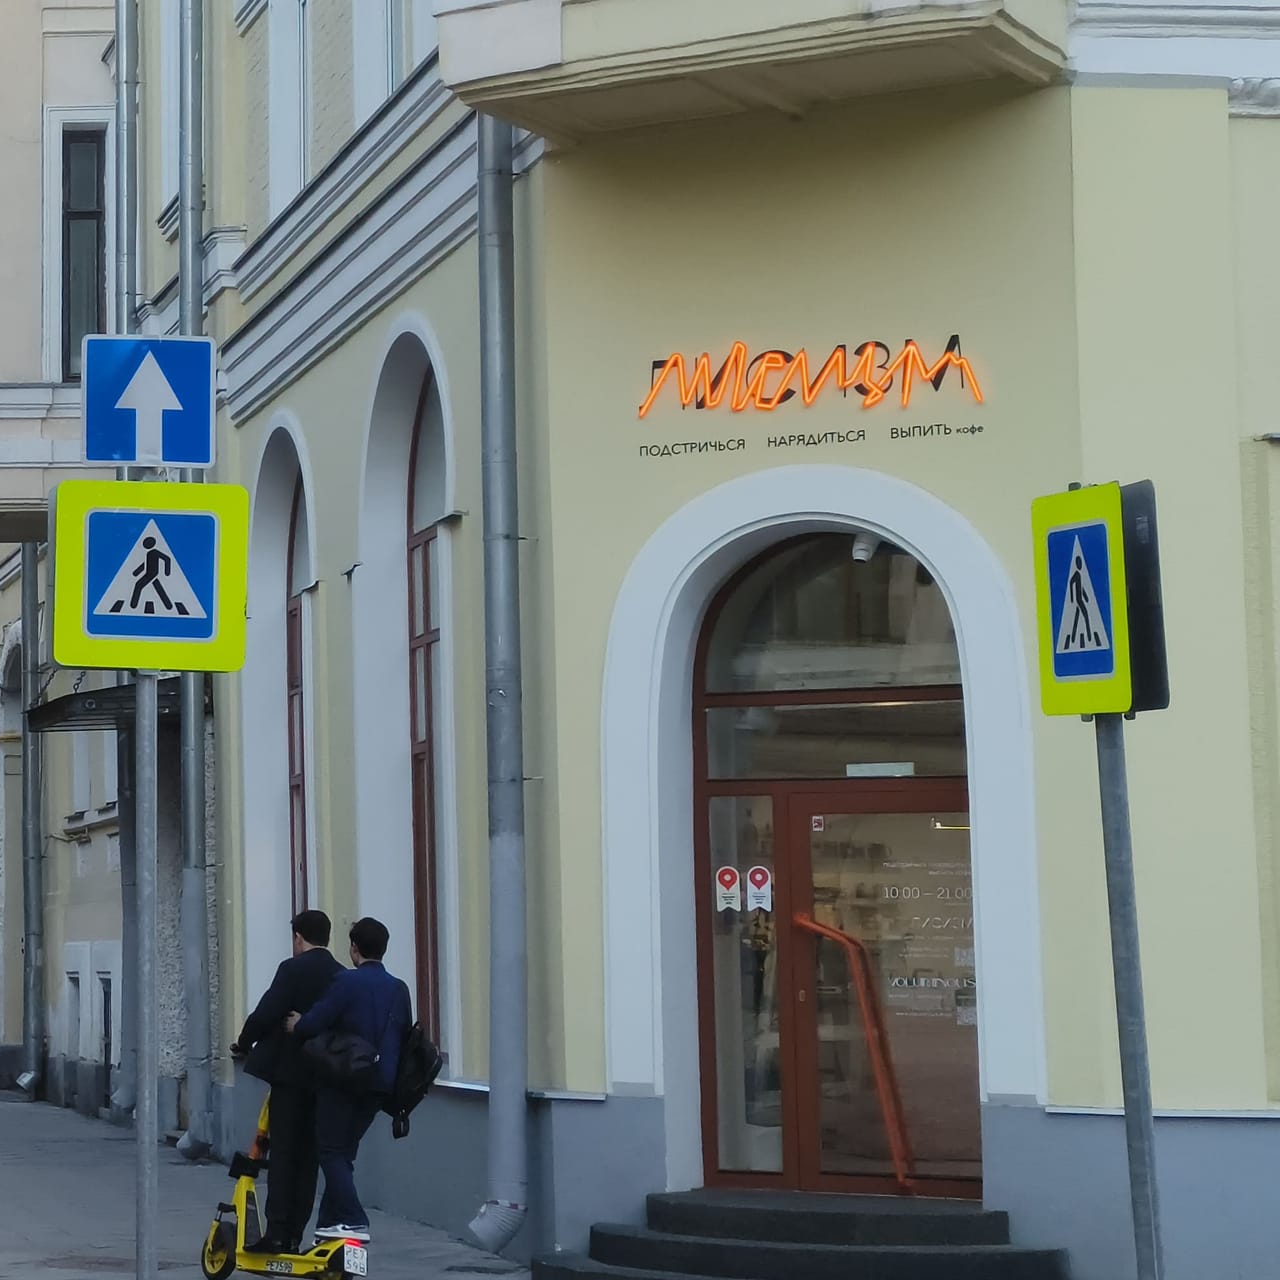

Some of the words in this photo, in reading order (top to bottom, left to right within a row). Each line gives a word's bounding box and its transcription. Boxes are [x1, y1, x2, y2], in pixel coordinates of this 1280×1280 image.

[639, 438, 746, 457] ПОДСТРИЧЬСЯ
[767, 429, 866, 448] НАРЯДИТЬСЯ
[890, 423, 952, 439] ВЫПИТЬ
[956, 424, 984, 435] кофе
